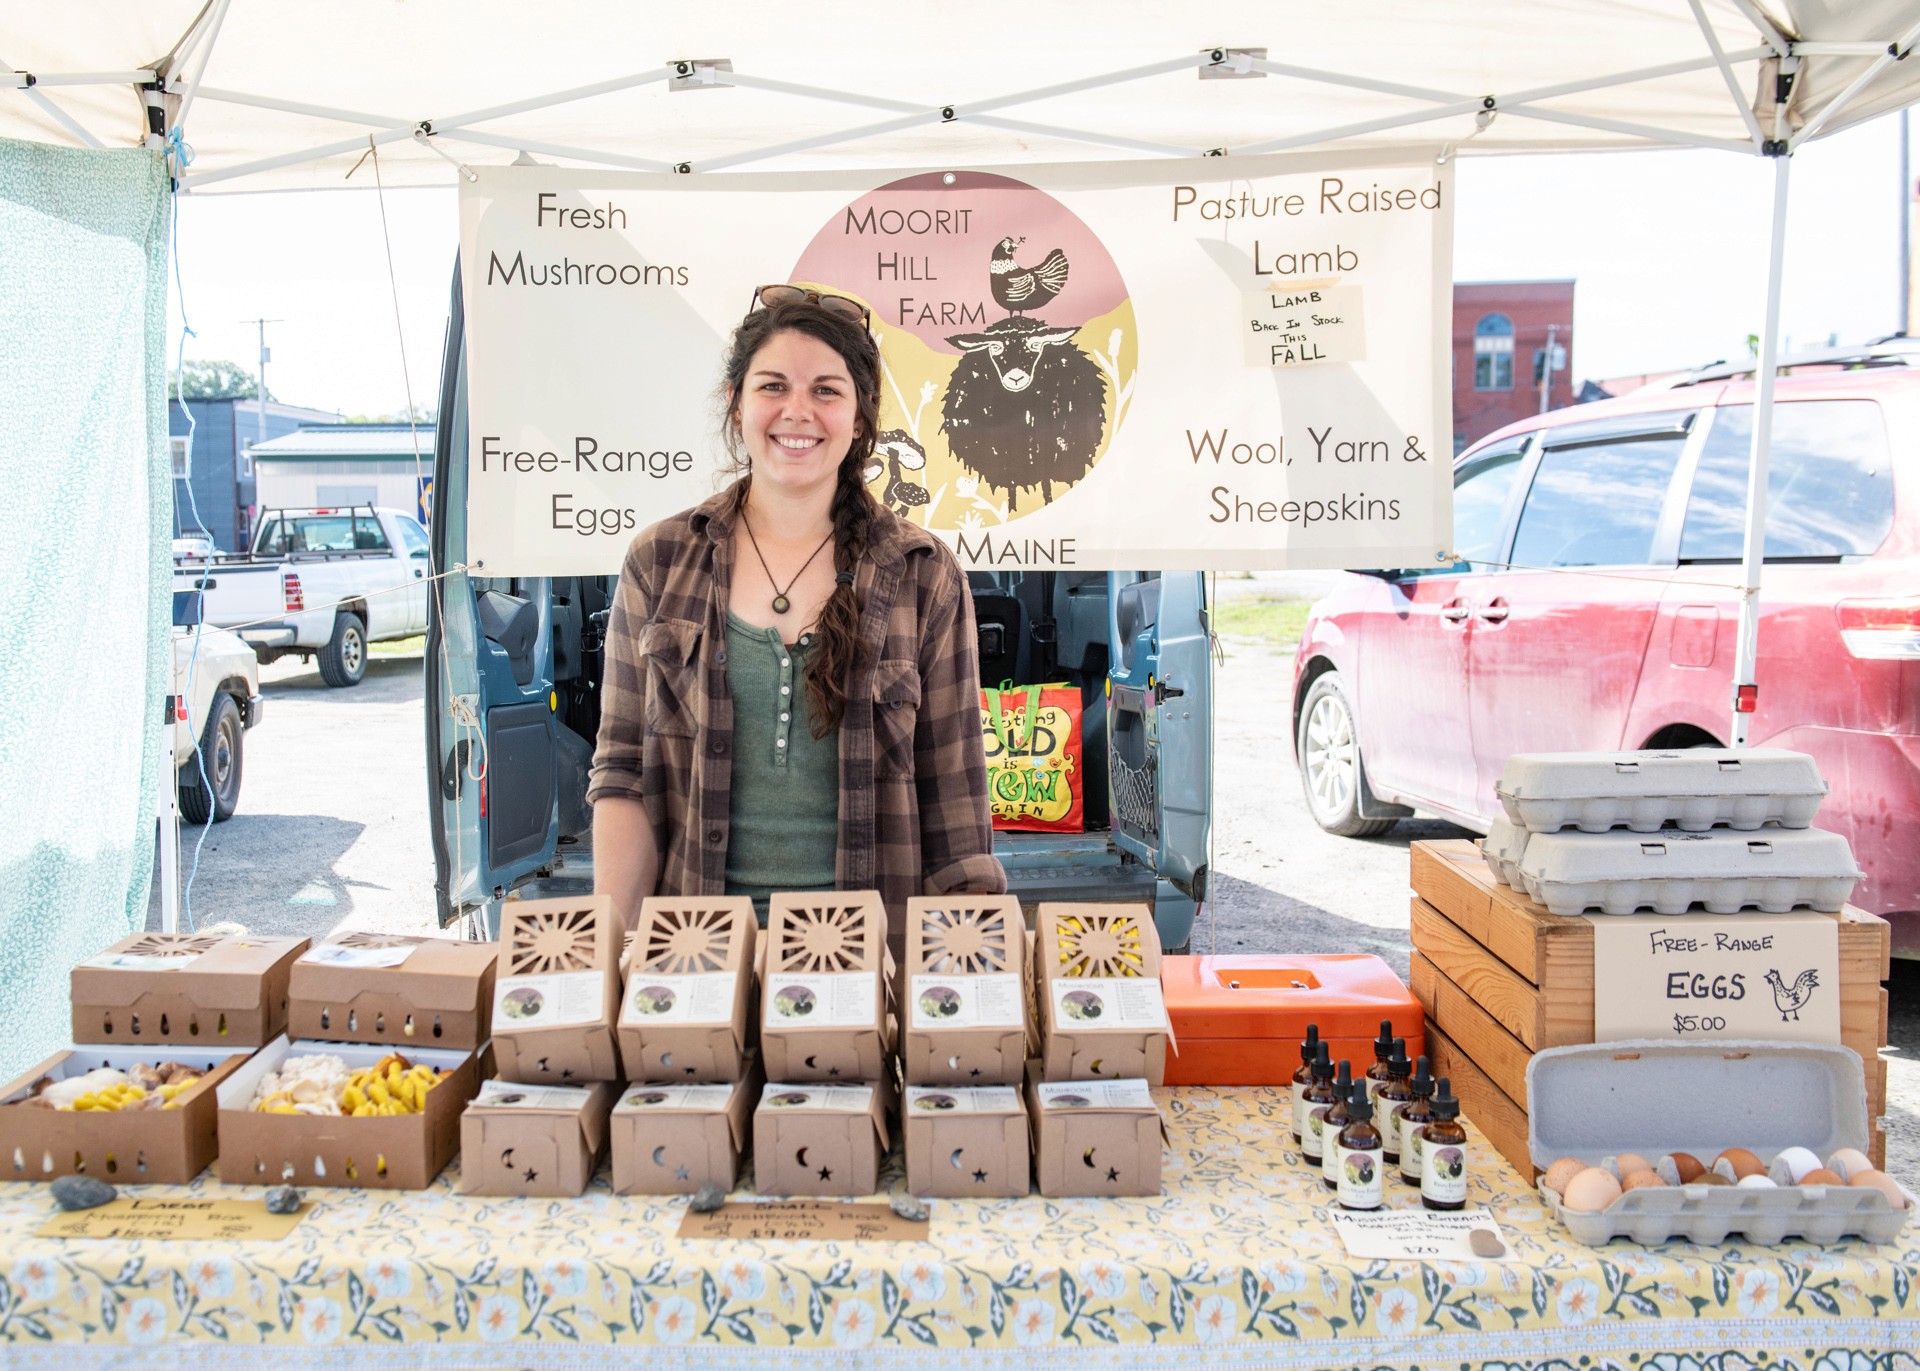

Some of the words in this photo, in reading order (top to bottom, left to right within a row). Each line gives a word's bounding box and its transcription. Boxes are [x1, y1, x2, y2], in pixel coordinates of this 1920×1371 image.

[538, 193, 626, 229] Fresh
[1174, 186, 1304, 221] Pasture
[1321, 178, 1441, 214] Raised
[846, 206, 972, 234] MOORIT
[488, 250, 688, 286] Mushrooms
[878, 252, 937, 280] HILL
[1255, 240, 1358, 275] Lamb
[900, 298, 985, 325] FARM
[1272, 292, 1322, 308] LAMB
[1272, 343, 1326, 365] FALL
[482, 437, 693, 479] Free-Range
[1186, 429, 1292, 466] Wool,
[1307, 427, 1388, 463] Yarn
[1403, 435, 1427, 463] &
[552, 494, 636, 536] Eggs
[1210, 486, 1400, 528] Sheepskins
[957, 532, 1076, 565] MAINE
[983, 726, 1056, 757] OLD
[991, 804, 1044, 816] GAIN
[1650, 929, 1773, 954] FREE-RANGE
[1667, 971, 1745, 1000] EGGS
[1673, 1013, 1726, 1034] $5.00
